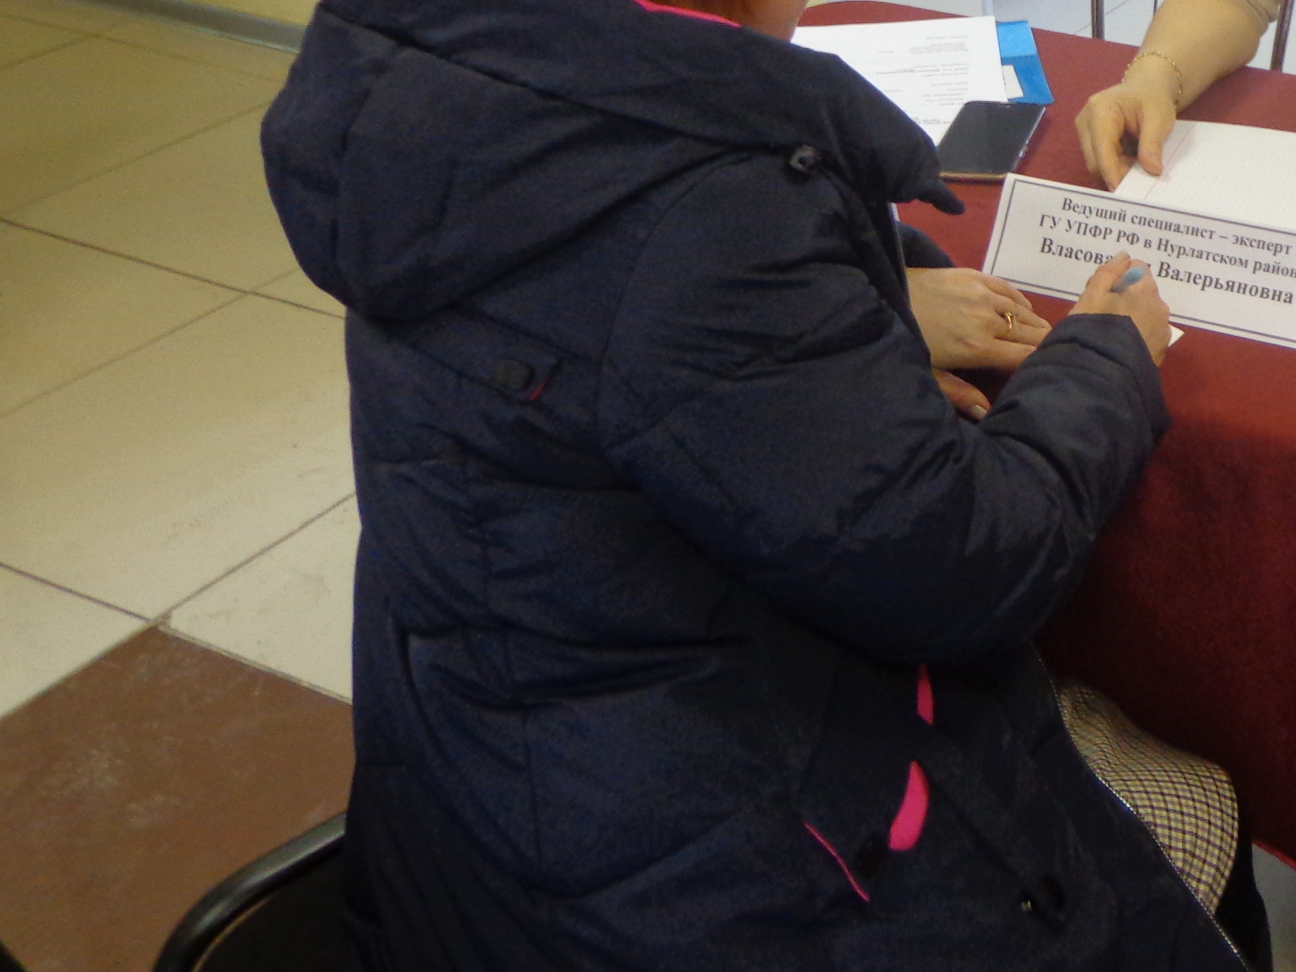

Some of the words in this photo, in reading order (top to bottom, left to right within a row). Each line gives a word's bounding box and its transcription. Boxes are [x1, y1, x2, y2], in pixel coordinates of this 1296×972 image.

[1040, 214, 1061, 229] ГУ
[1065, 218, 1113, 241] УПФР
[1116, 229, 1140, 246] РФ
[1143, 238, 1152, 249] в
[1156, 237, 1249, 270] Нурлатском
[1062, 197, 1127, 223] Ведущий
[1131, 213, 1215, 241] специалист
[1231, 233, 1294, 258] эксперт
[1156, 261, 1294, 305] Валерьяновна
